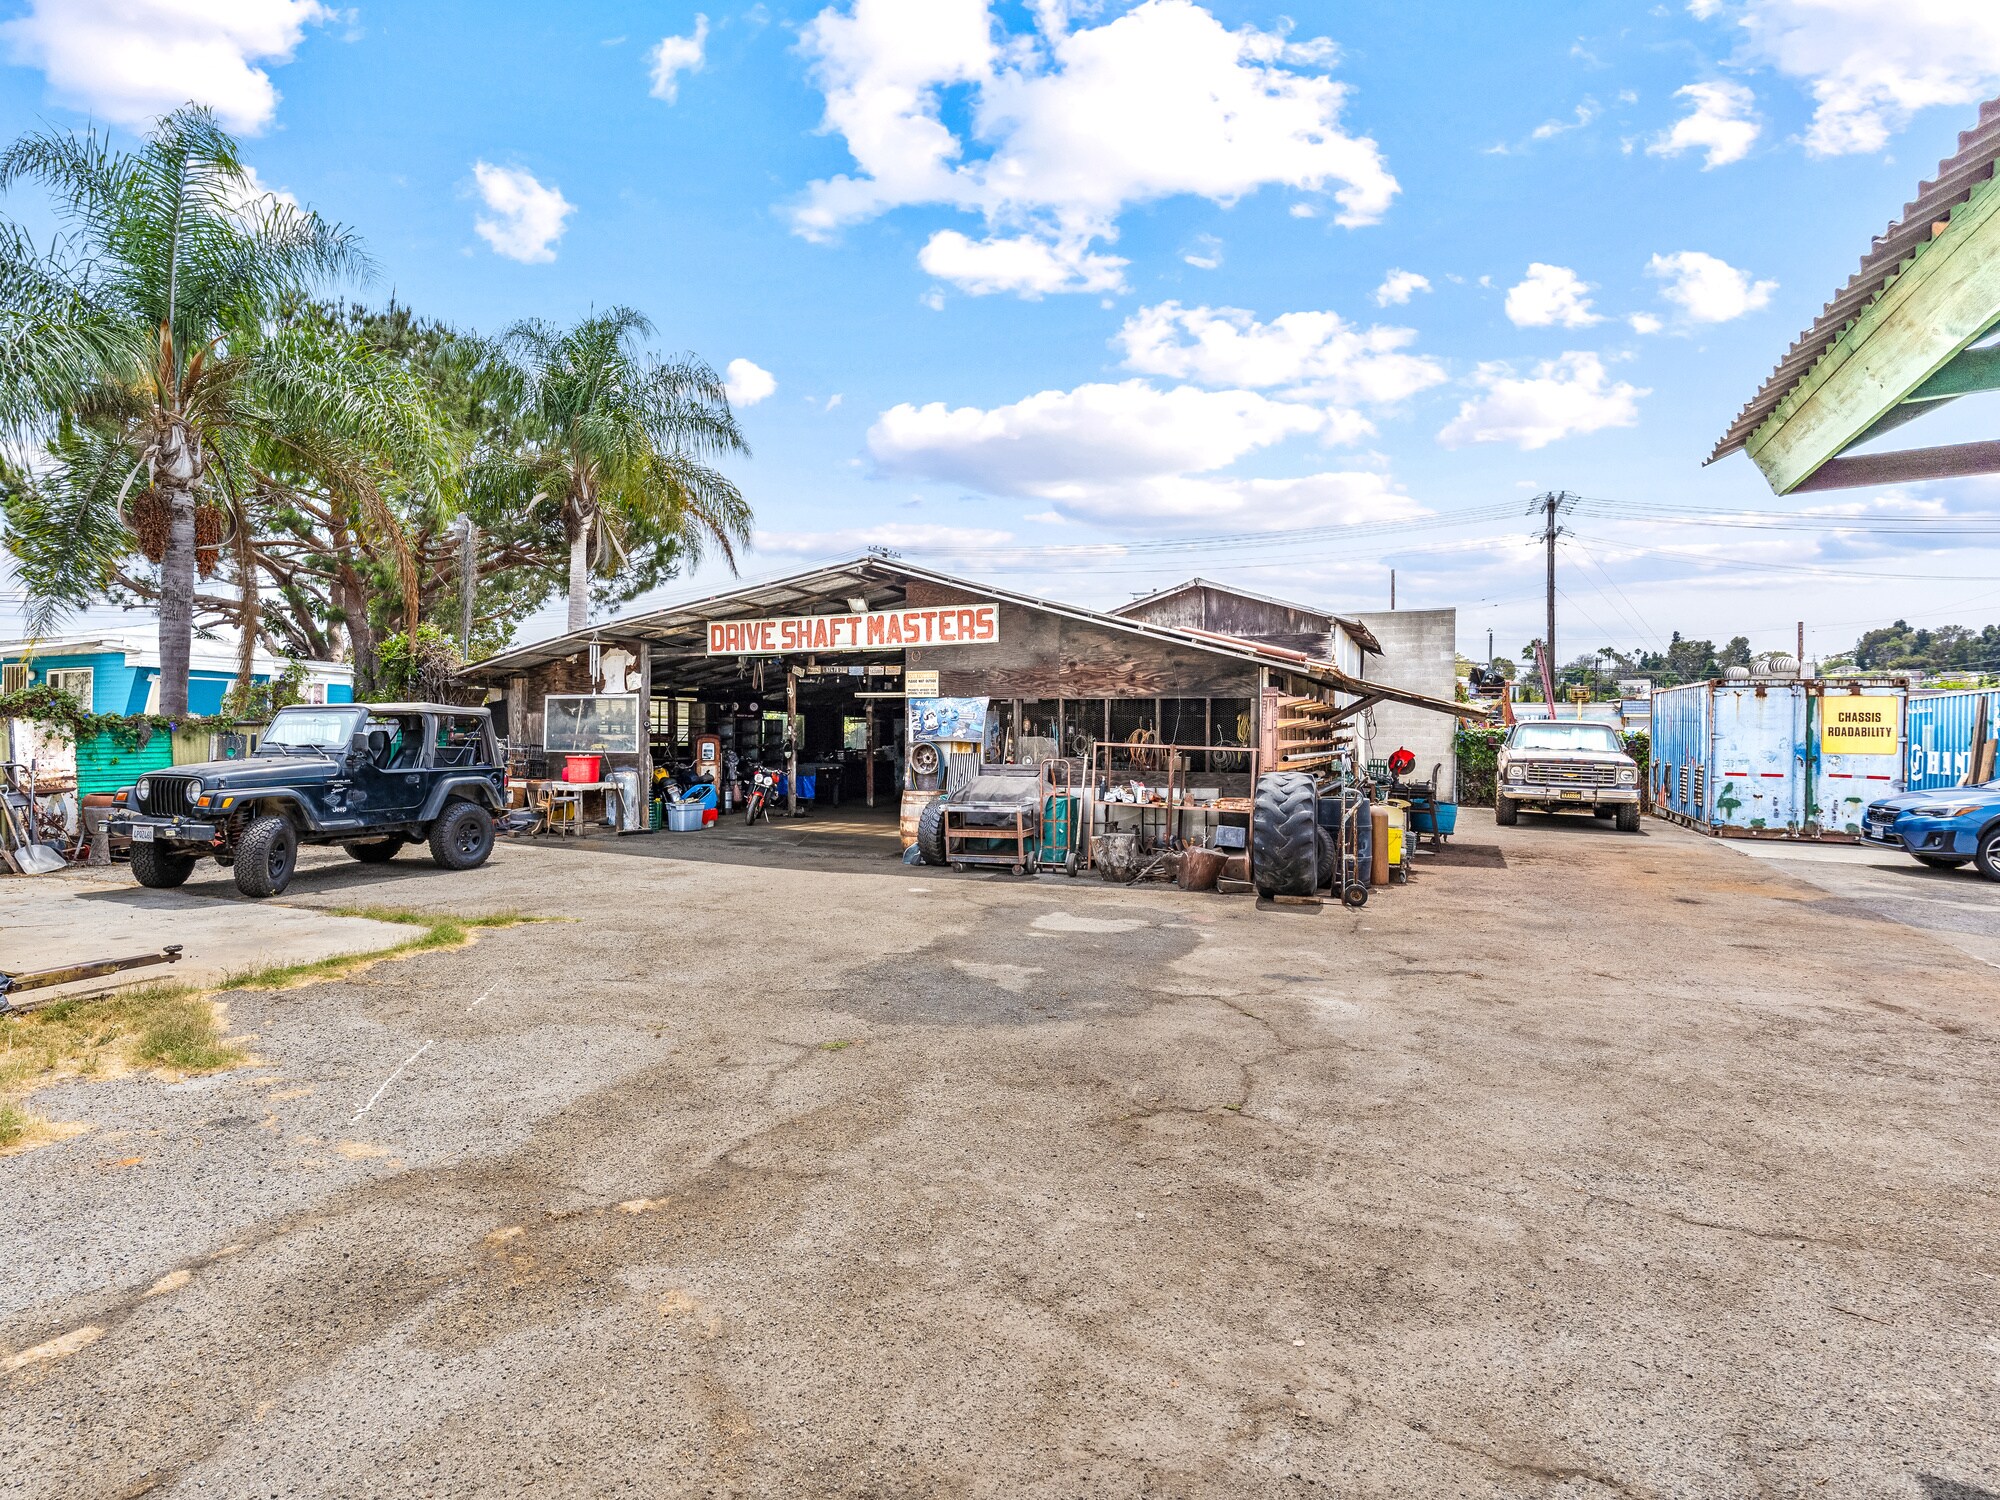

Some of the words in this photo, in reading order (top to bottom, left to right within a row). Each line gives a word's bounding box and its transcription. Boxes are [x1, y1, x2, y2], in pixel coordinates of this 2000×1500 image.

[711, 621, 776, 652] DRIVE
[781, 616, 862, 648] SHAFT
[867, 607, 994, 646] MASTERS
[1838, 712, 1882, 723] CHASSIS
[1828, 727, 1892, 738] ROADABILITY
